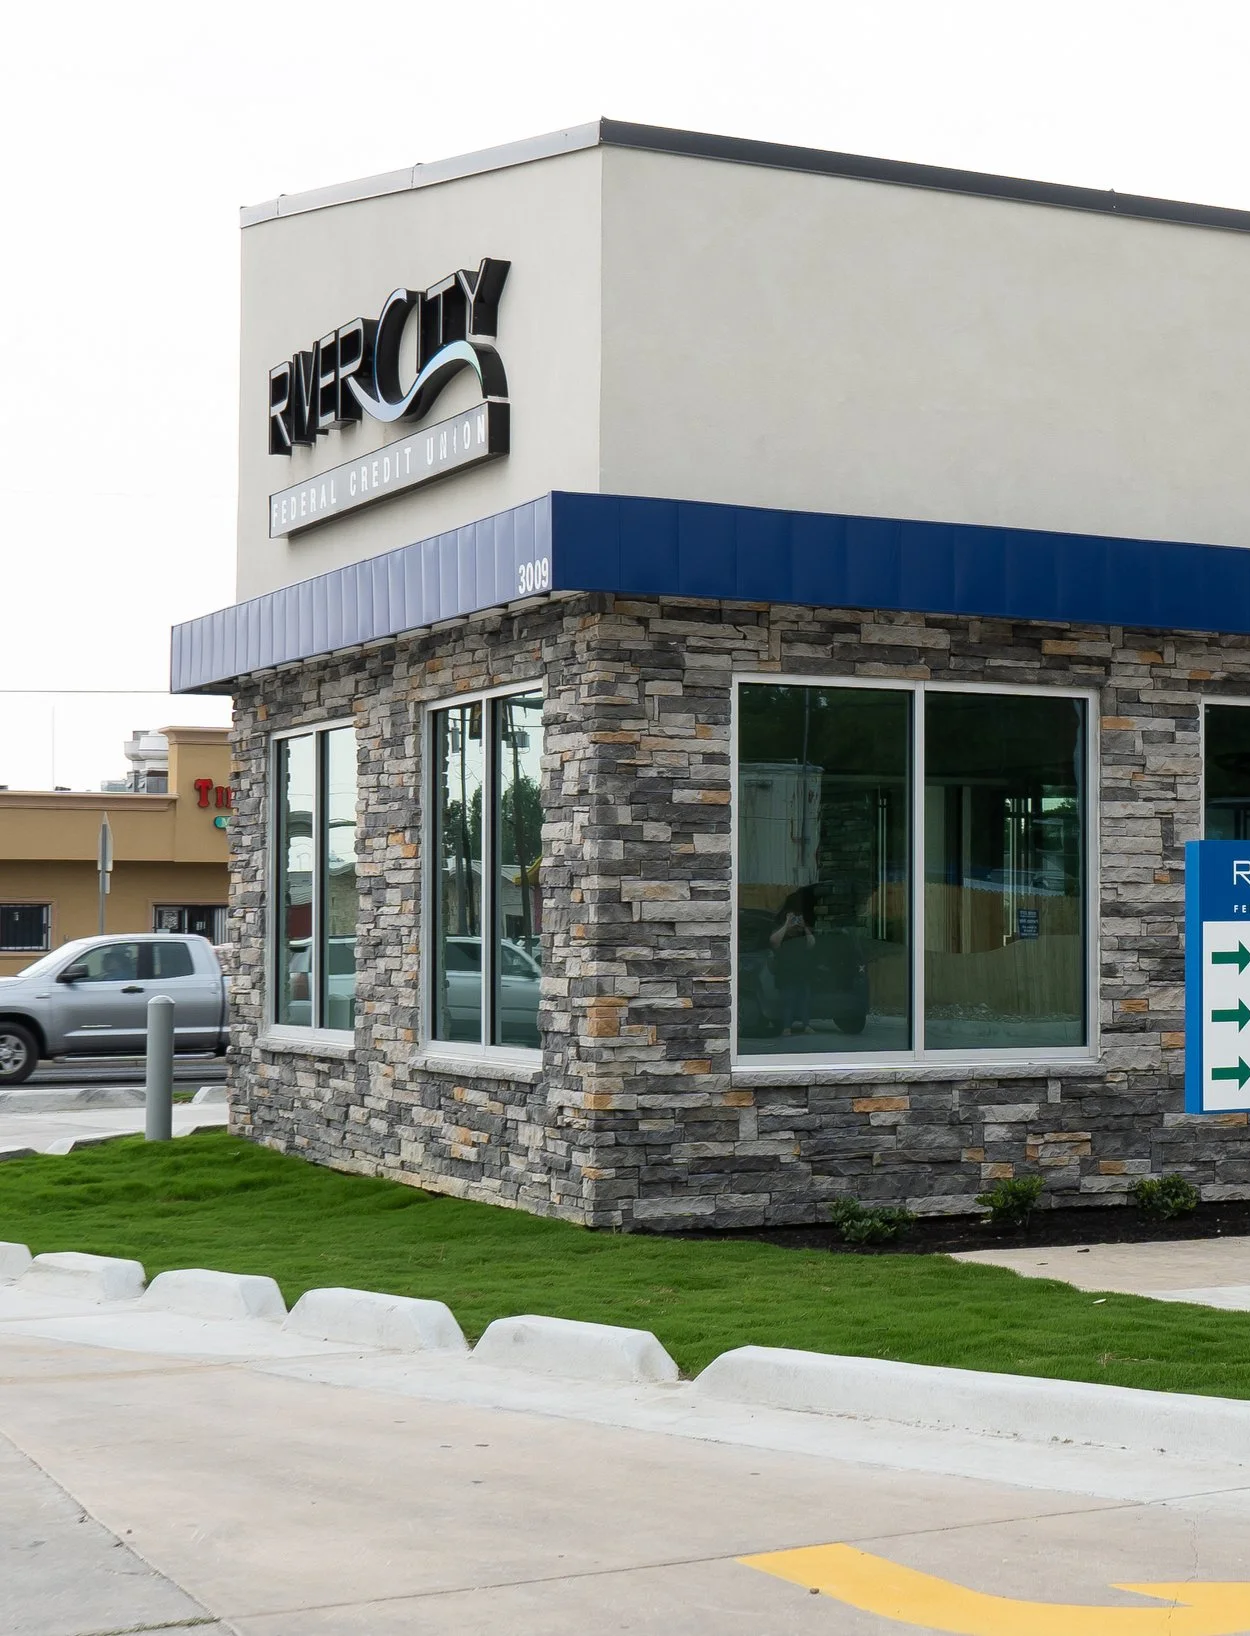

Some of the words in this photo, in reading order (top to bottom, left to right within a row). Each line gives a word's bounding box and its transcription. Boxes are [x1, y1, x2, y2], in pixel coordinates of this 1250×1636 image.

[269, 317, 379, 456] RIVER
[374, 257, 511, 418] CITY
[272, 479, 337, 528] FEDERAL
[350, 447, 413, 497] CREDIT
[426, 413, 486, 466] UNION
[518, 557, 549, 595] 3009
